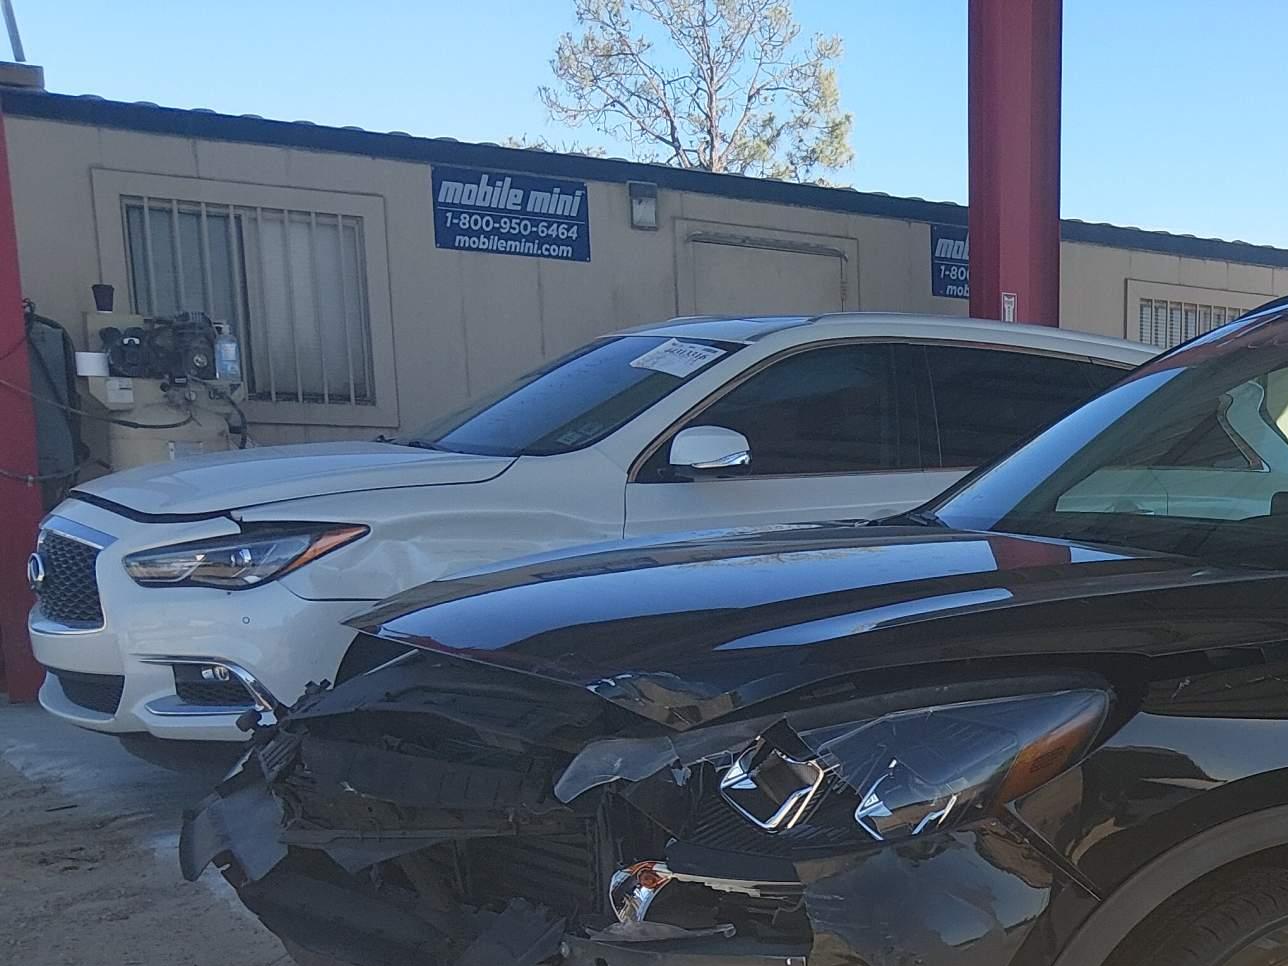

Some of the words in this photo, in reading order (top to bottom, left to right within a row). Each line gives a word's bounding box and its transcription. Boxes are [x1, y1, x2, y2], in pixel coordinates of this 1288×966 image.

[438, 174, 523, 210] mobile
[526, 187, 584, 216] mini
[445, 212, 578, 240] 1-800-950-6464
[455, 234, 573, 257] mobilemini.com
[940, 265, 969, 280] 1-80
